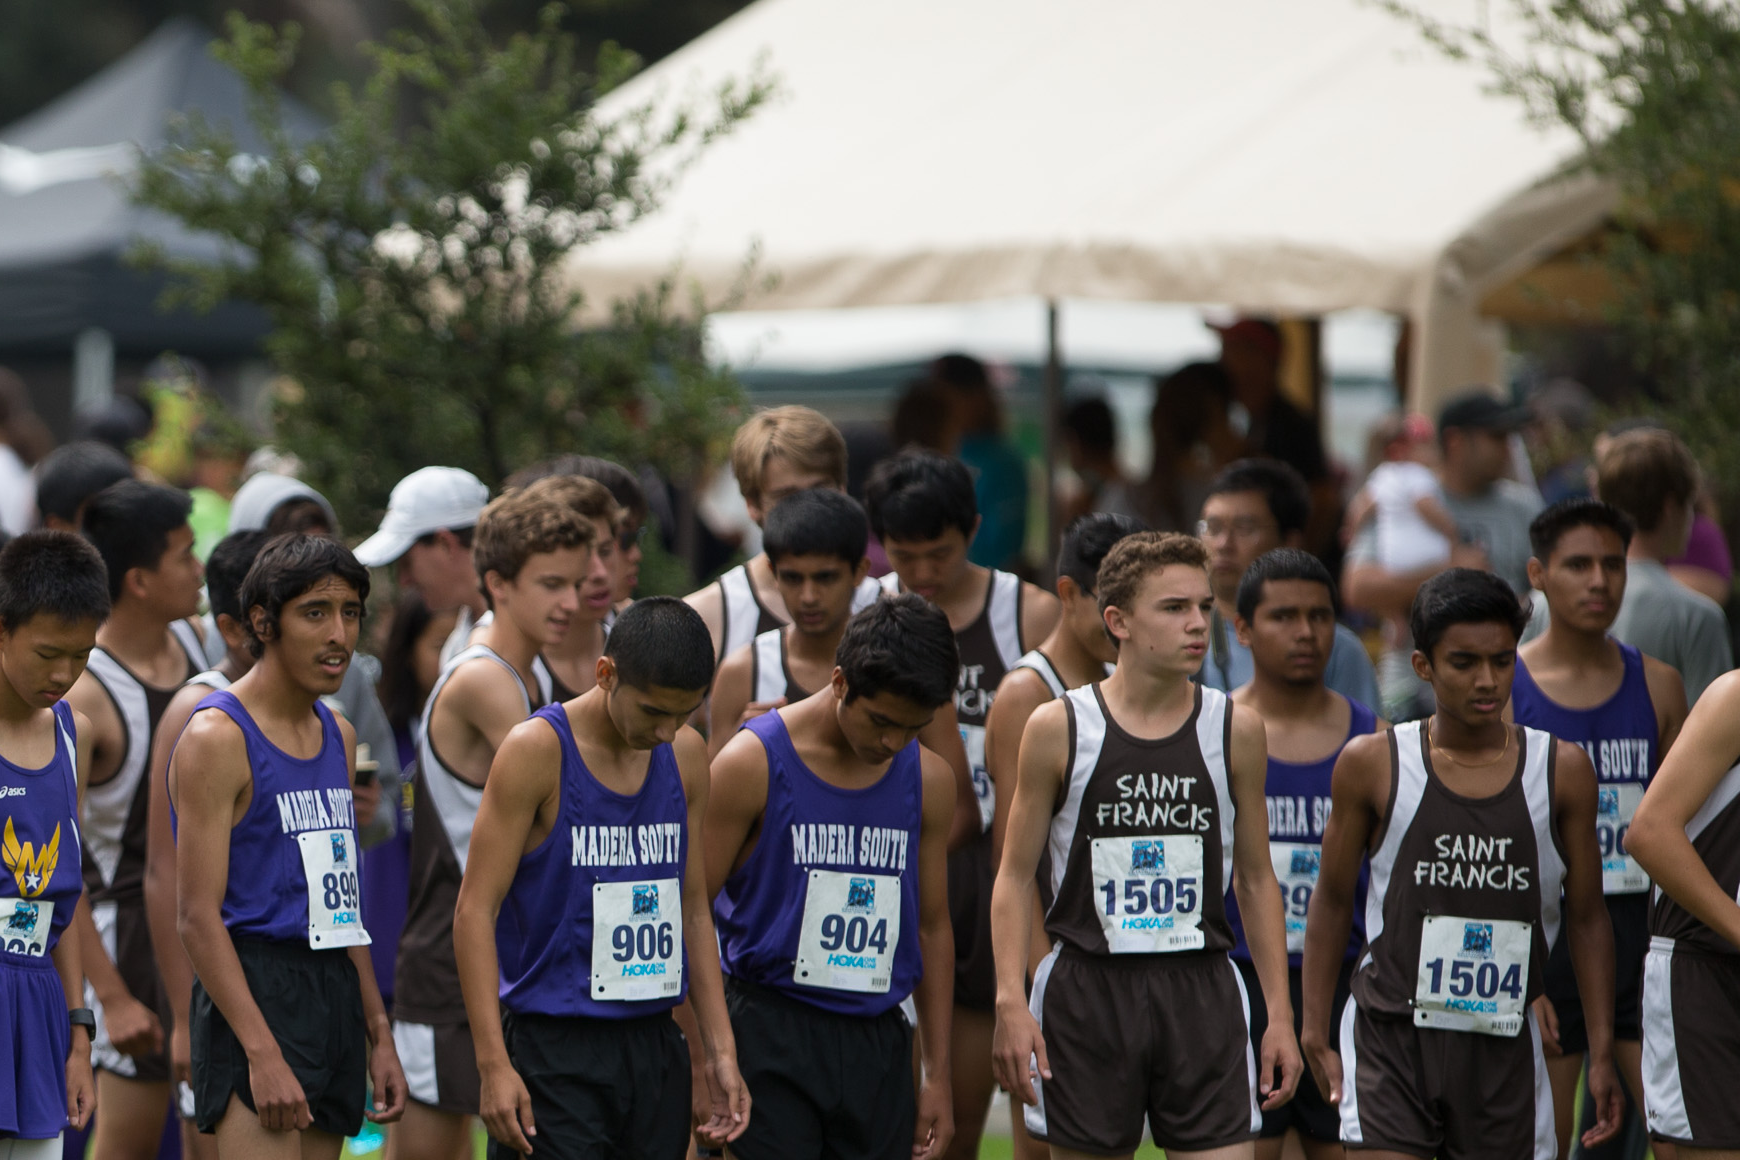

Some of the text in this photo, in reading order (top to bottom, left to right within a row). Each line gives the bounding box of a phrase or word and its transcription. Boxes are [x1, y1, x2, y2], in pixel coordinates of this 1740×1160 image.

[7, 787, 26, 796] asics
[1116, 773, 1197, 800] SAINT
[1096, 802, 1212, 831] FRANCIS
[572, 825, 637, 866] MADERA
[791, 824, 909, 870] MADERA SOUTH
[1435, 834, 1512, 862] SAINT
[1414, 861, 1530, 891] FRANCIS
[323, 872, 358, 911] 899
[1100, 878, 1197, 916] 1505
[820, 914, 887, 955] 904
[1122, 917, 1161, 929] HOKA
[612, 922, 673, 962] 906
[622, 963, 656, 976] HOKA
[827, 953, 864, 968] HOKA
[1426, 957, 1522, 999] 1504
[1445, 998, 1484, 1012] HOKA
